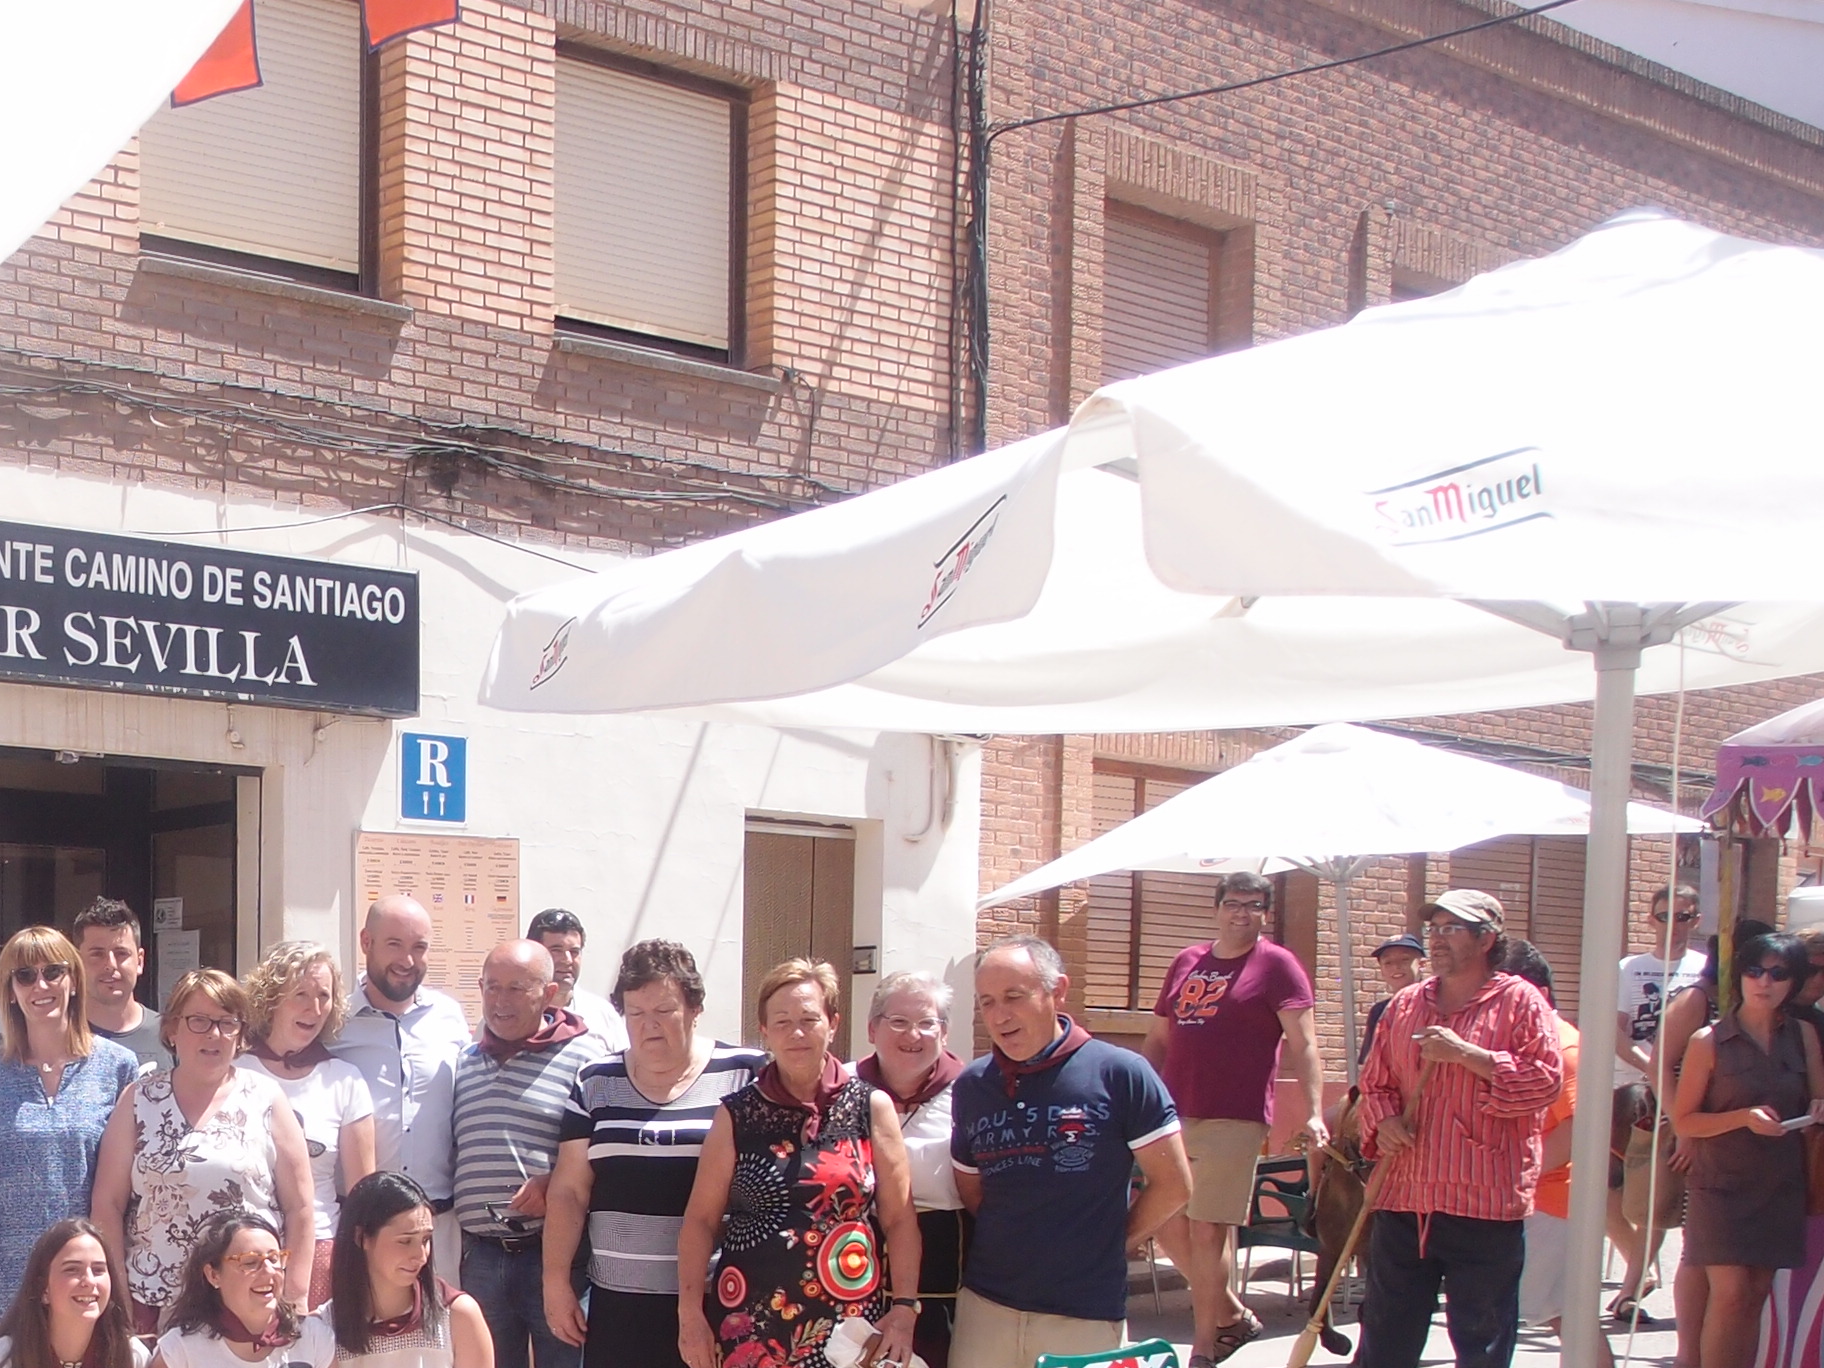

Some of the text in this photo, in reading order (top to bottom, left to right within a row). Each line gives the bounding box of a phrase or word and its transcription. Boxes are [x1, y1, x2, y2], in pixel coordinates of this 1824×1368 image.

[64, 547, 193, 600] CAMINO
[203, 565, 244, 606] DE
[253, 570, 406, 625] SANTIAGO
[63, 611, 318, 687] SEVILLA
[415, 739, 452, 788] R
